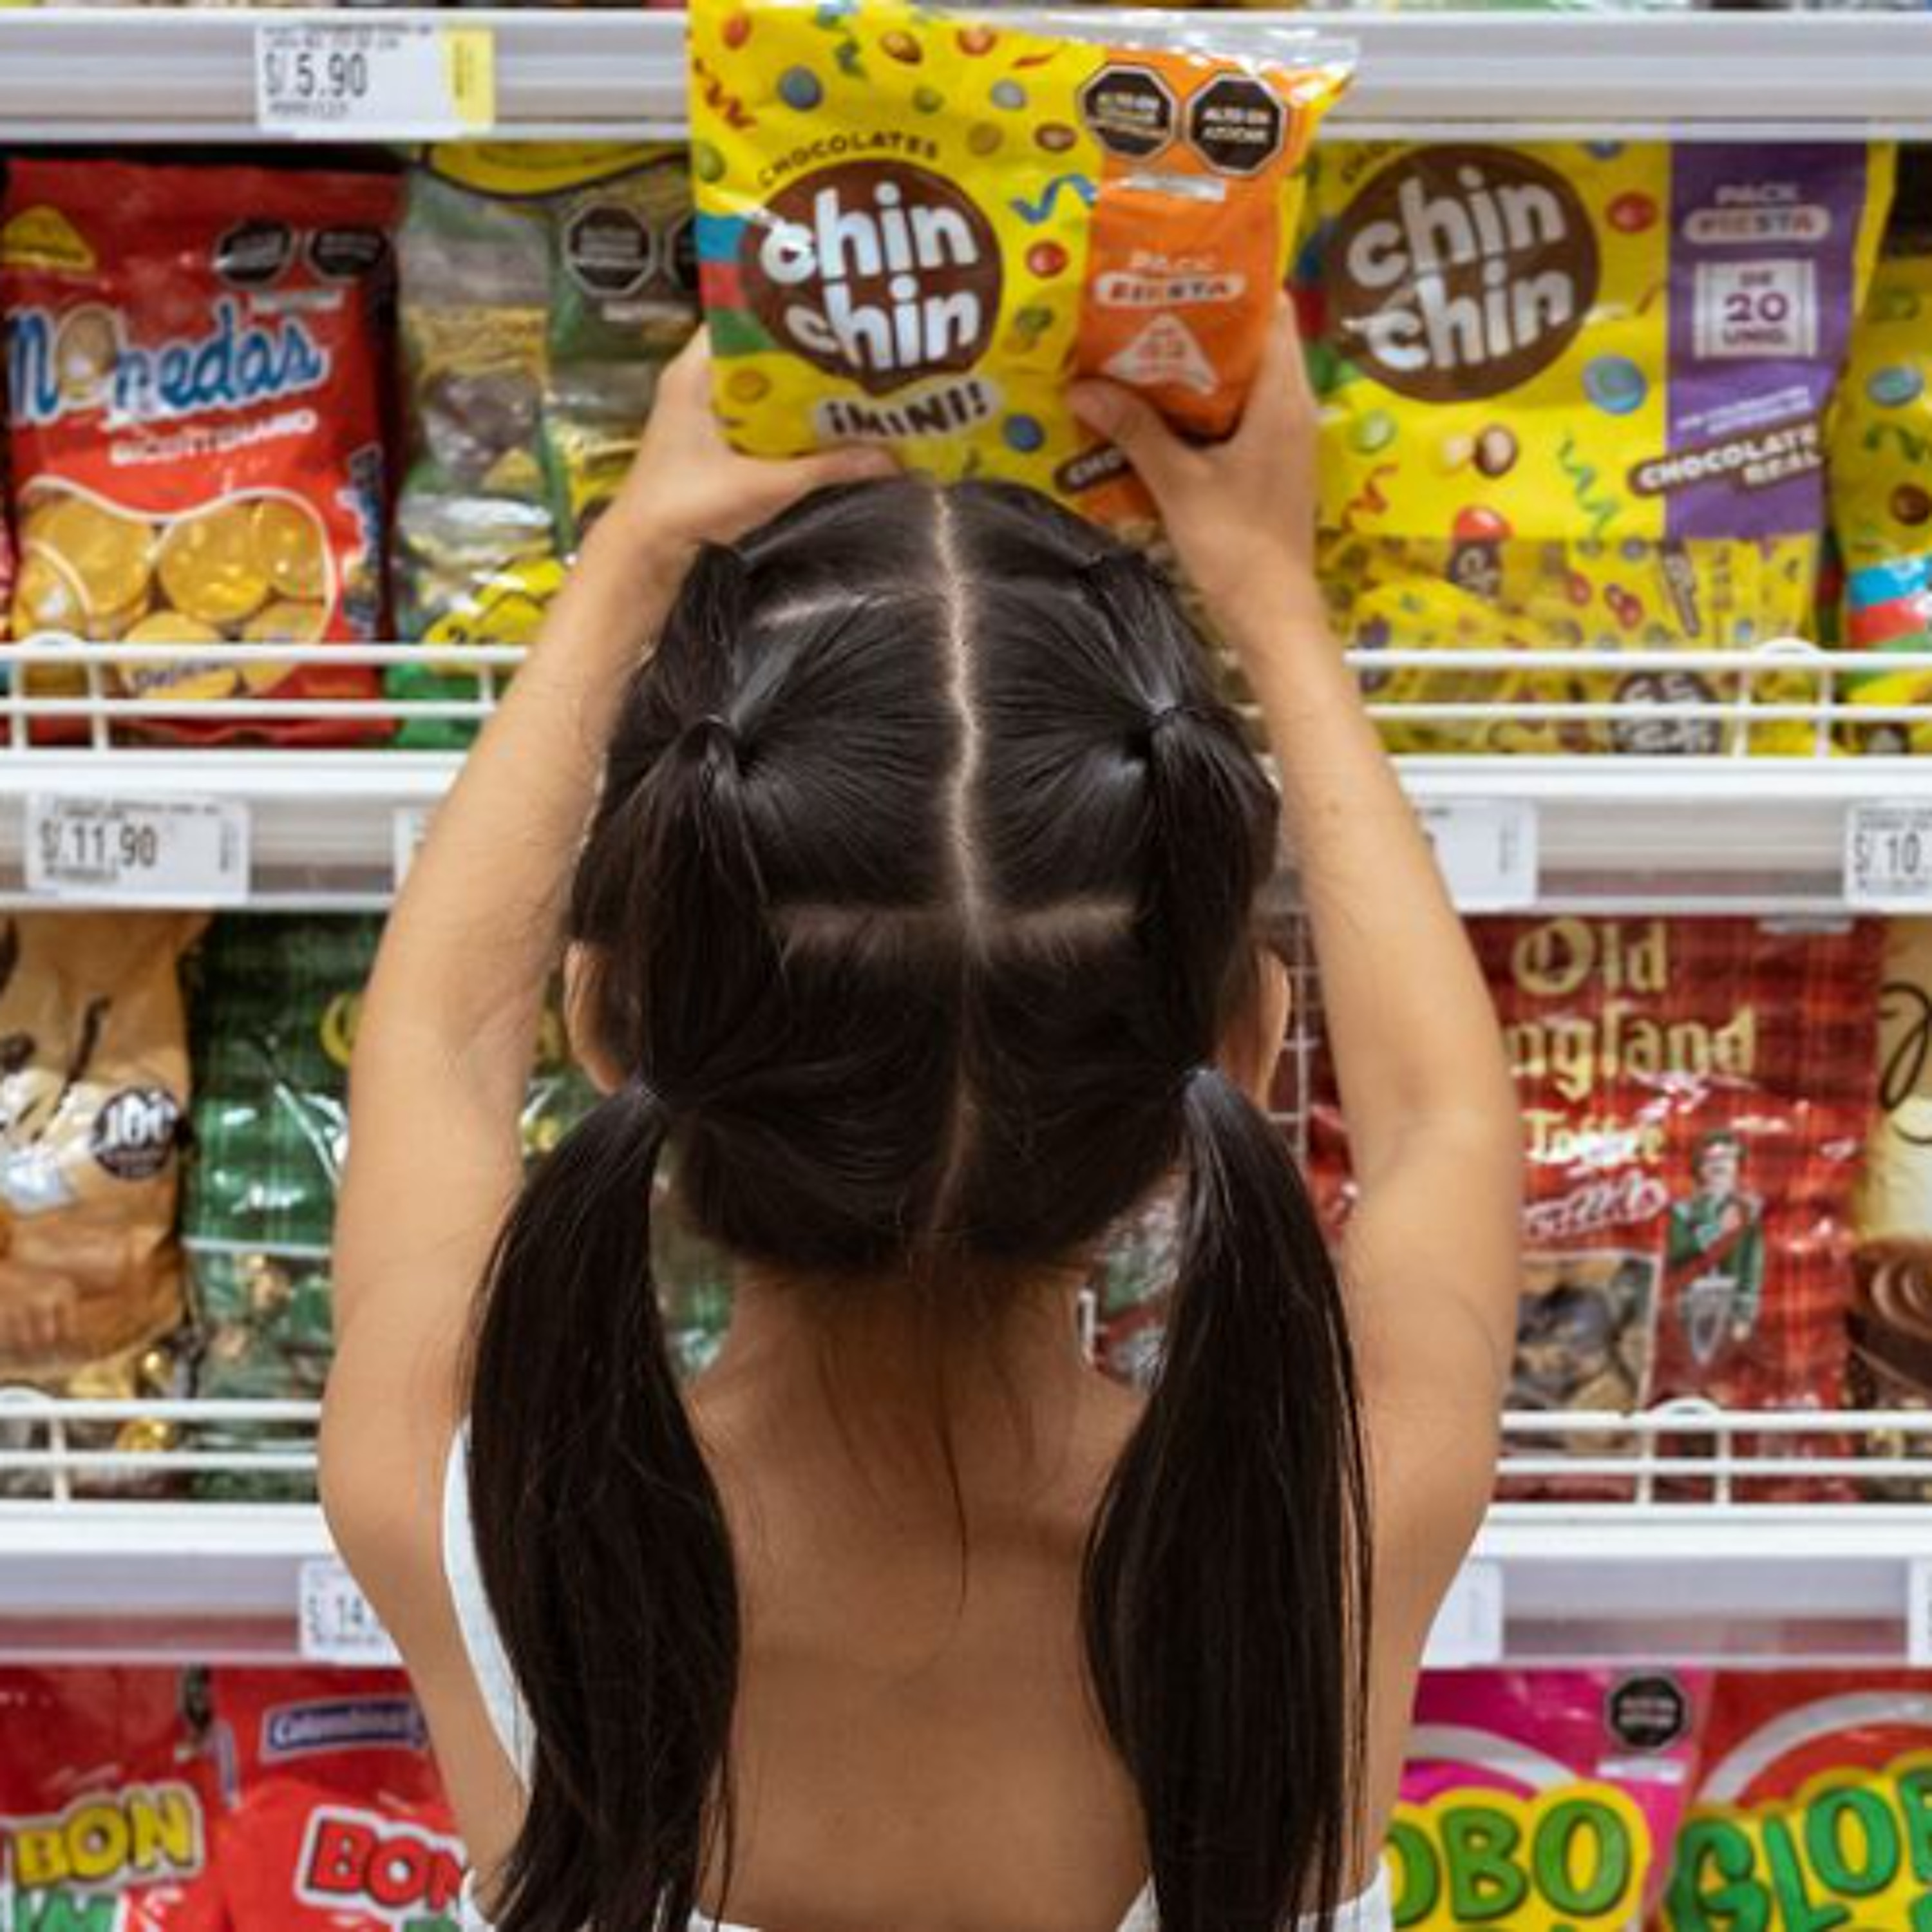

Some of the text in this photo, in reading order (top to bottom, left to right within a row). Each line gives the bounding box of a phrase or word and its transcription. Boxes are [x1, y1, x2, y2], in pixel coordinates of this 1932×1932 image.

[757, 131, 938, 187] CHOCOLATES
[759, 180, 979, 285] chin
[1346, 166, 1567, 289] chin
[1698, 217, 1816, 234] FIESTA
[785, 273, 980, 371] chin
[1364, 261, 1575, 372] chin
[1723, 293, 1789, 321] 20
[1638, 422, 1818, 488] CHOCOLATE
[1743, 451, 1822, 484] REAL
[1513, 916, 1668, 995] Old
[14, 1785, 196, 1887] BON
